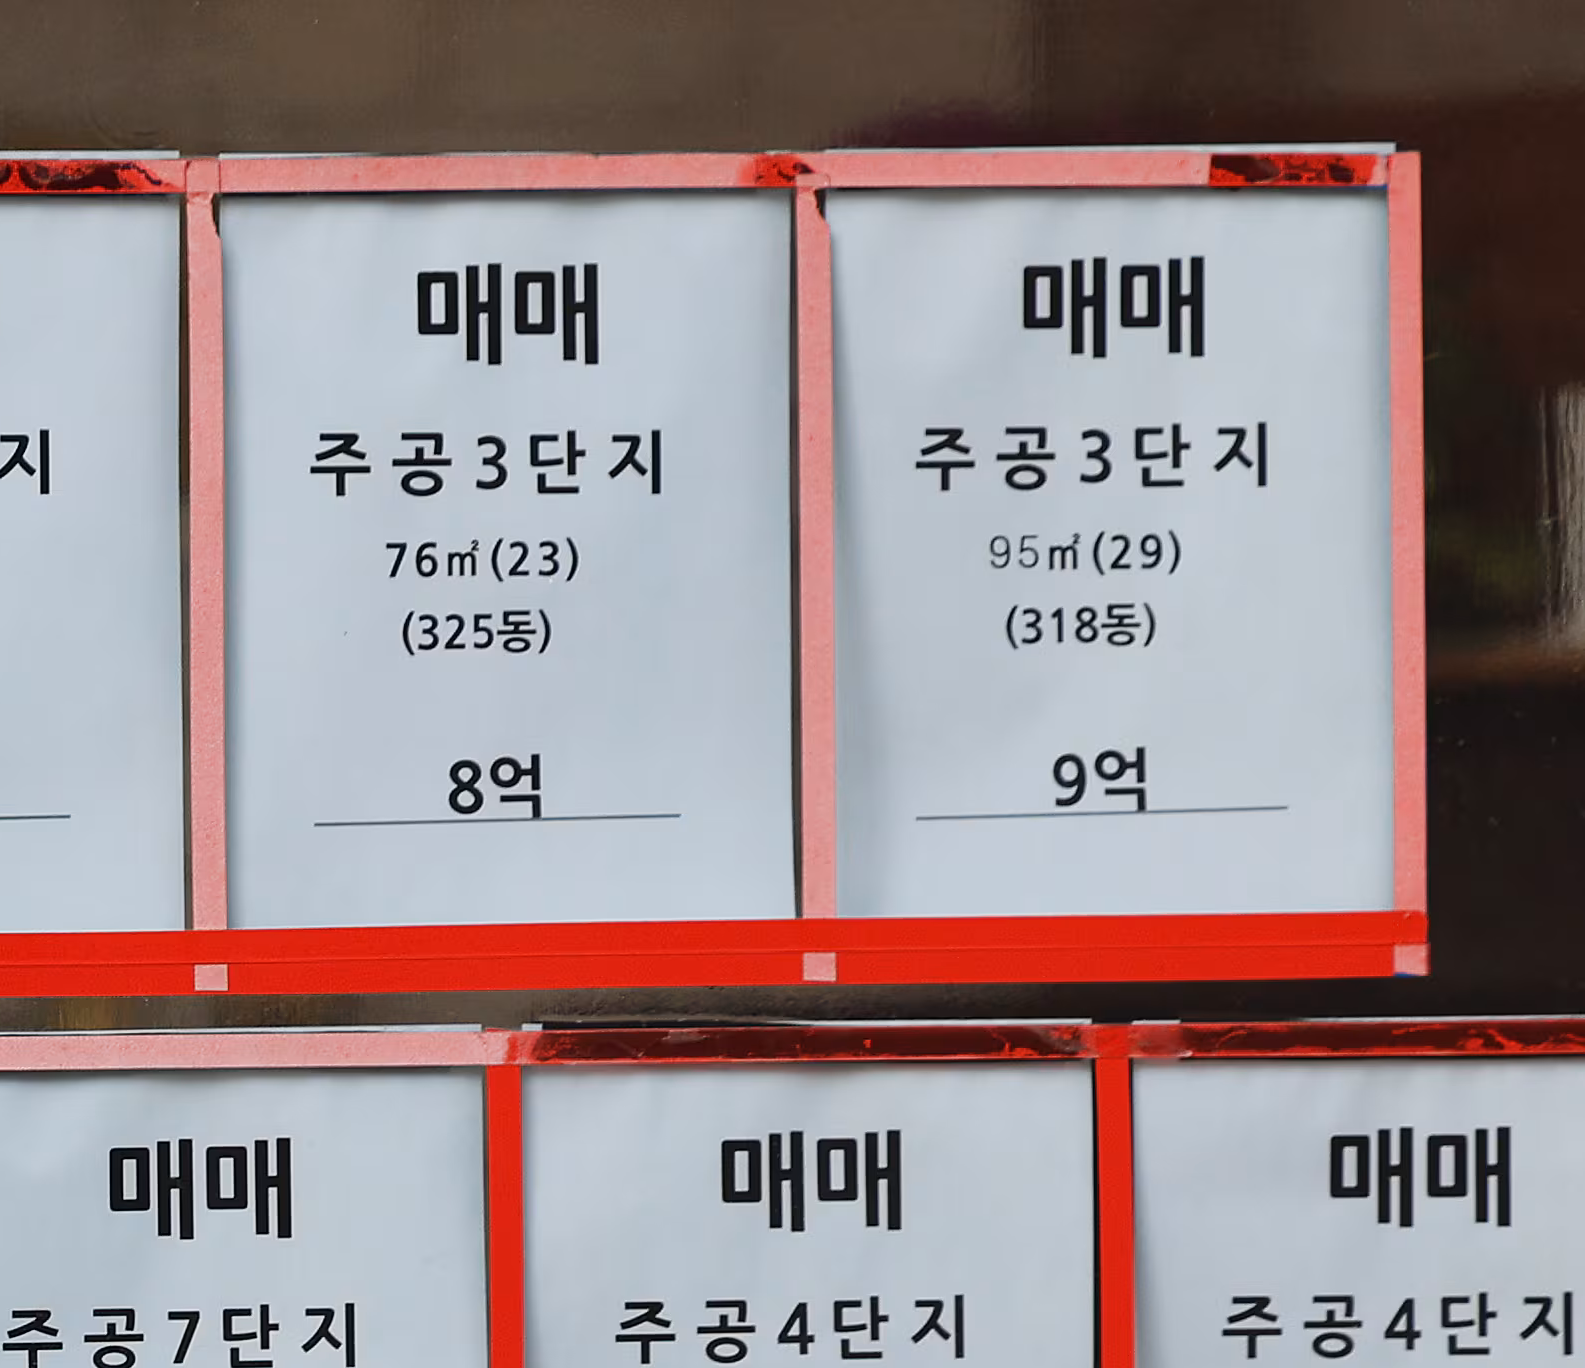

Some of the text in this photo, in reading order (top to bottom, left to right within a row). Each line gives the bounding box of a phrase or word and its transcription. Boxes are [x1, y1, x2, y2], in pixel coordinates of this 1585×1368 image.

[417, 263, 599, 366] 매매
[1023, 256, 1205, 359] 매매
[310, 430, 661, 497] 주공3단지
[915, 422, 1267, 491] 주공3단지
[403, 609, 551, 656] (325동)
[1006, 603, 1156, 649] (318동)
[449, 754, 541, 821] 8억
[1053, 747, 1146, 814] 9억
[109, 1138, 292, 1240] 매매
[721, 1130, 902, 1232] 매매
[1330, 1126, 1511, 1228] 매매
[615, 1295, 964, 1364] 주공4단지
[1222, 1291, 1573, 1359] 주공4단지
